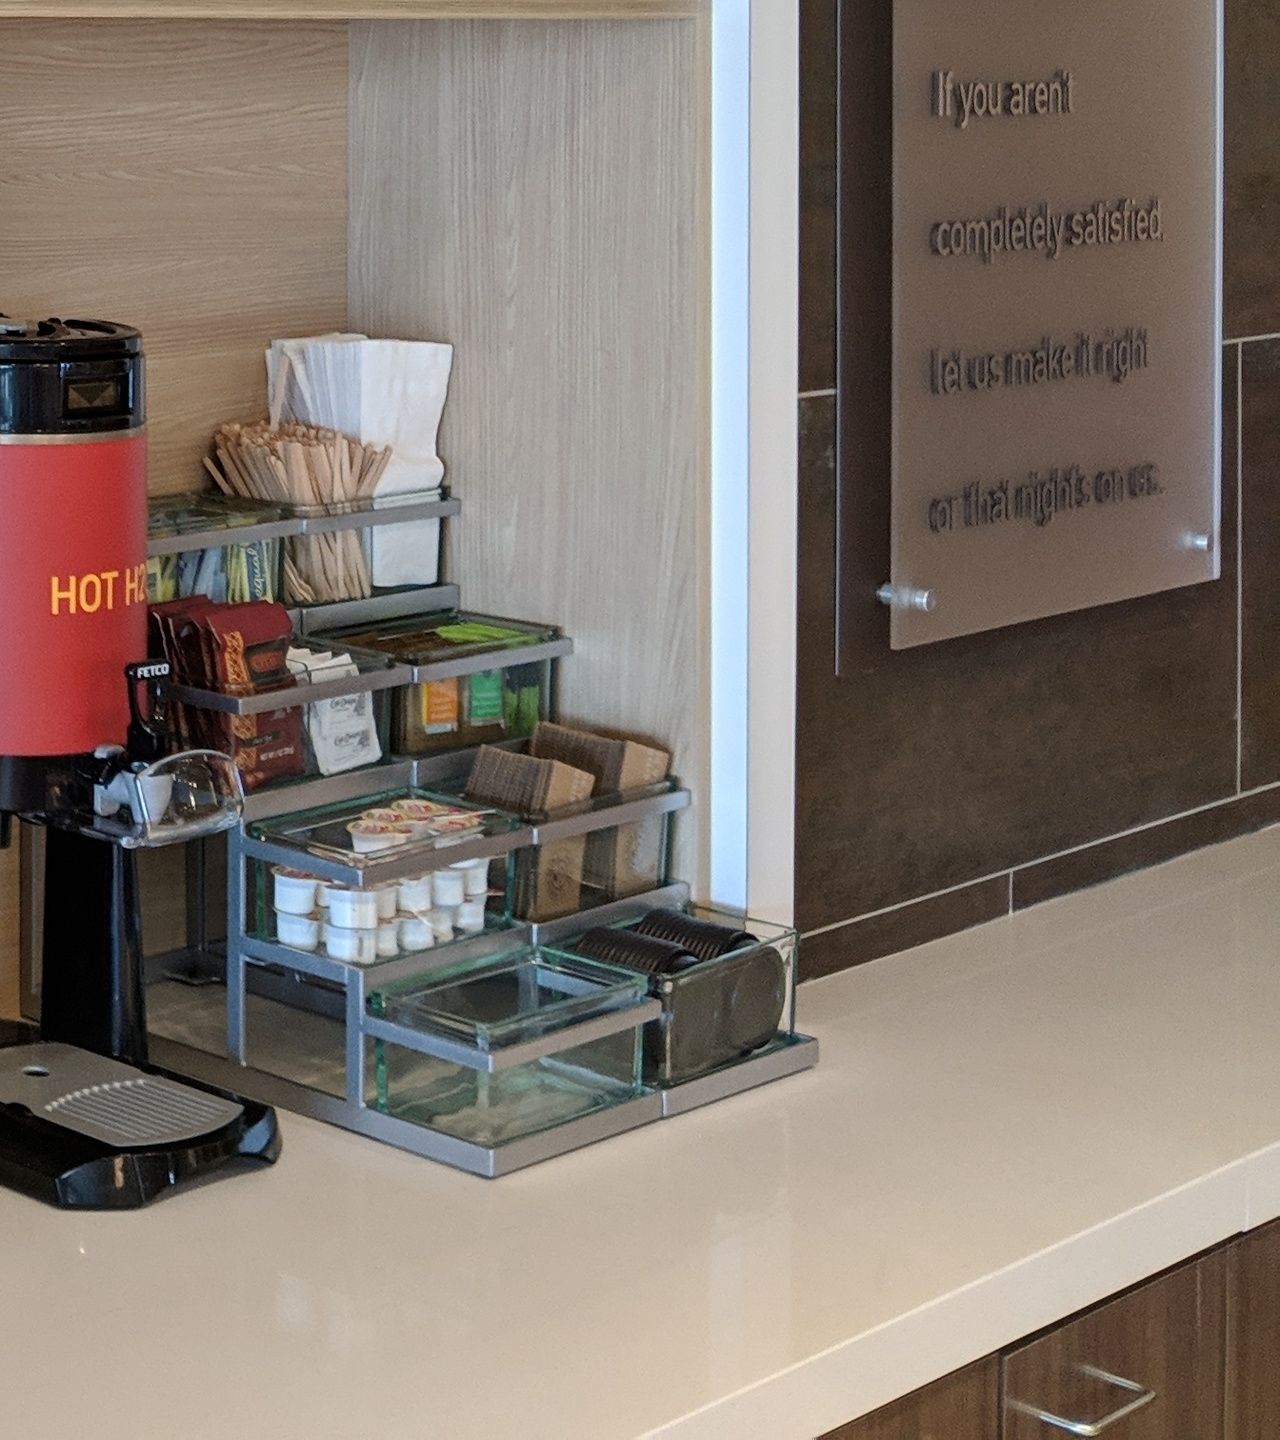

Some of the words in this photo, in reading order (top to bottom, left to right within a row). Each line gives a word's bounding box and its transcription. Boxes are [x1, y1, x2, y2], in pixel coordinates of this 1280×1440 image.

[933, 70, 953, 118] If
[956, 79, 1001, 129] you
[931, 202, 1064, 264] completely
[1003, 336, 1072, 385] make
[1092, 328, 1148, 385] right
[929, 496, 955, 533] or
[51, 570, 119, 616] HOT
[246, 547, 265, 598] equal
[137, 663, 170, 679] FETCO
